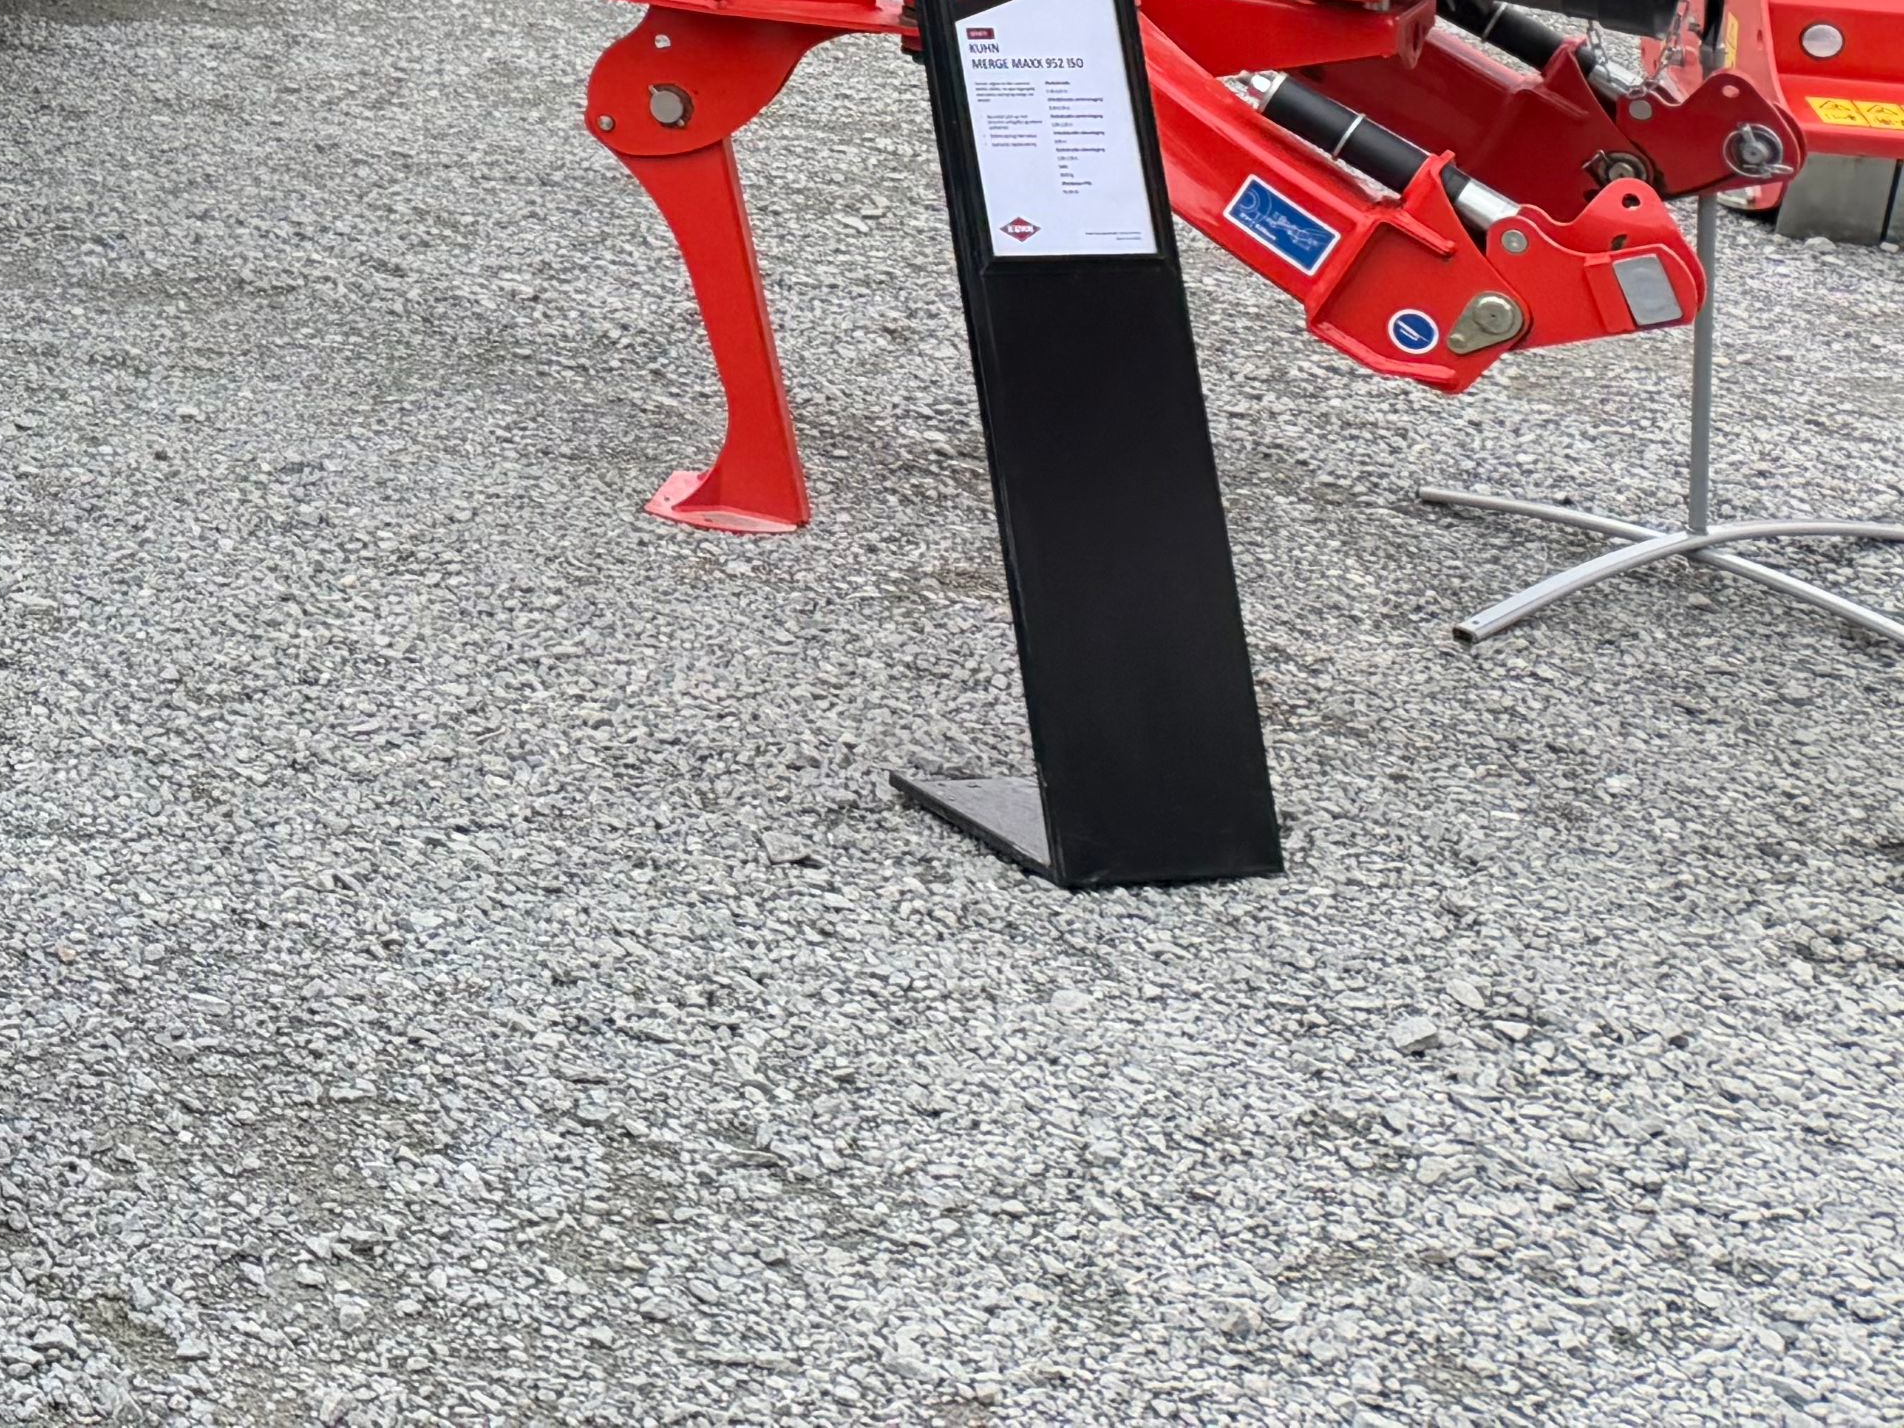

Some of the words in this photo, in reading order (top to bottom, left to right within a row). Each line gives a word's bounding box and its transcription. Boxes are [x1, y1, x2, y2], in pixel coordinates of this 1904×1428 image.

[969, 43, 1000, 54] KUHN
[972, 58, 1009, 70] MERGE
[1012, 58, 1044, 69] MAXX
[1045, 57, 1064, 69] 952
